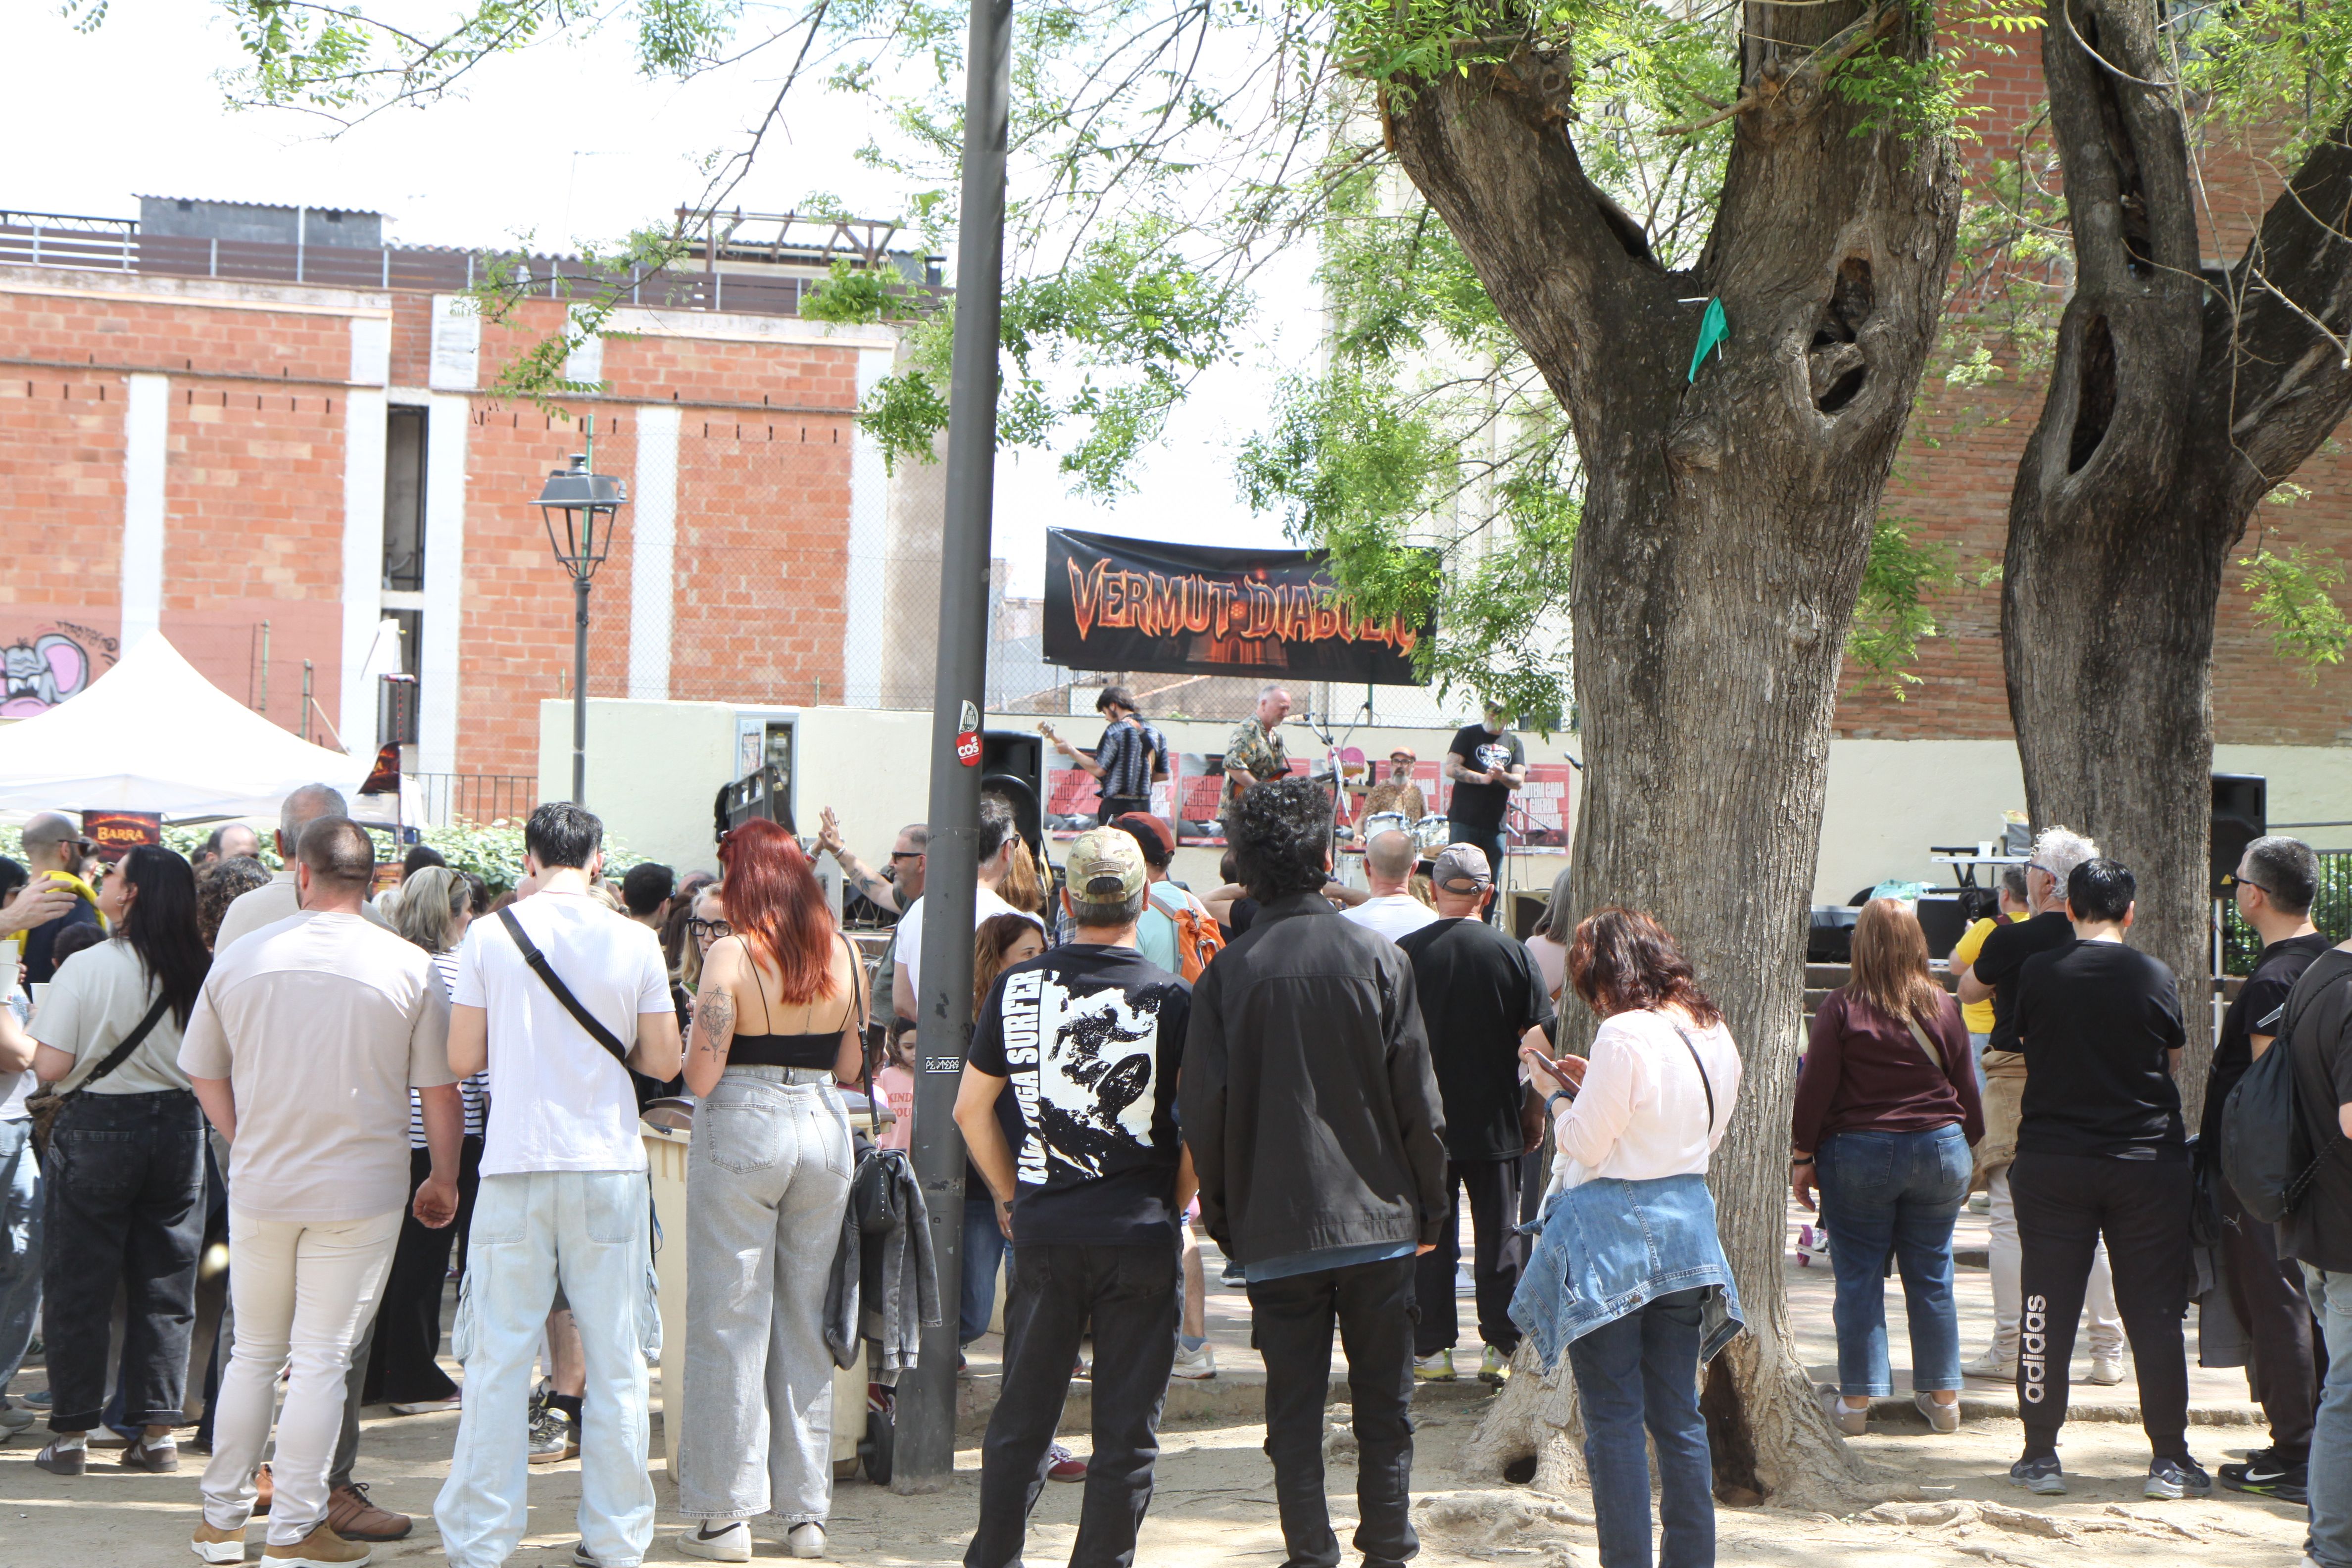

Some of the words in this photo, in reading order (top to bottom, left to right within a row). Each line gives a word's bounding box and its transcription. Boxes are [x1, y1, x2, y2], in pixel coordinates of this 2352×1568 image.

[1068, 556, 1237, 641] VERMUT
[958, 742, 979, 757] COS
[1479, 747, 1510, 758] TRIUMPH
[1530, 798, 1558, 814] GUERRA
[97, 827, 145, 841] BARRA
[1002, 969, 1044, 1064] SURFER
[2022, 1295, 2046, 1404] adidas
